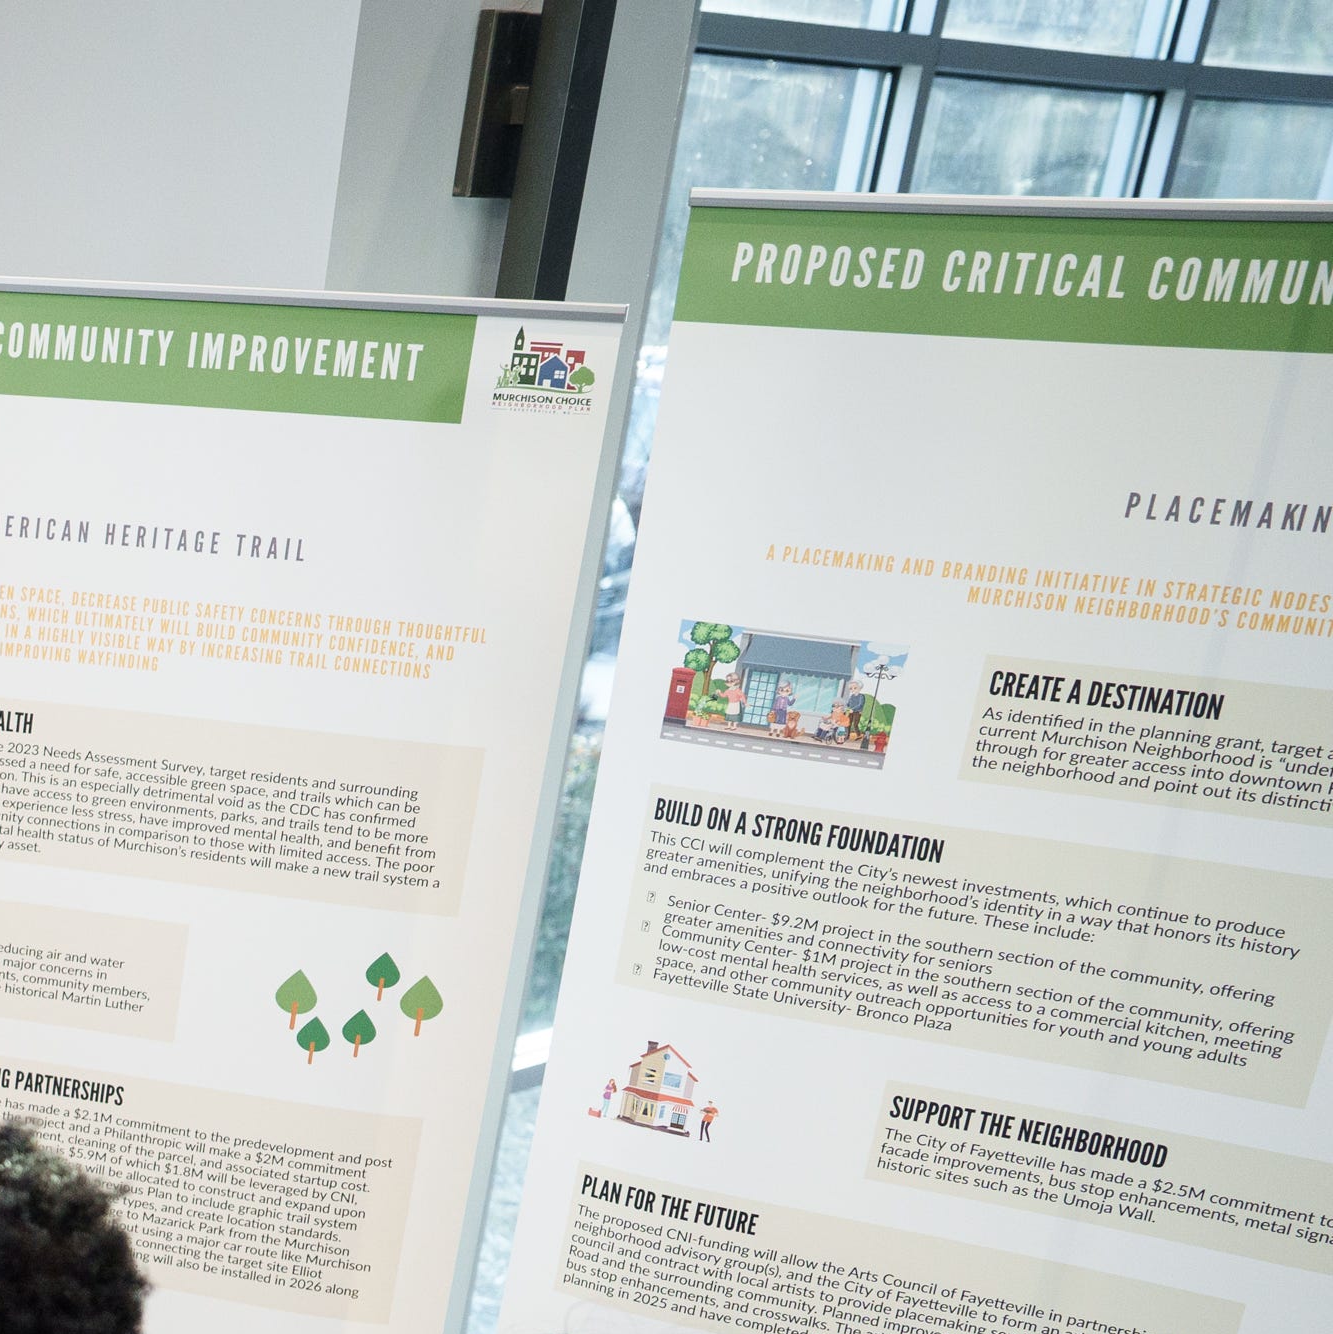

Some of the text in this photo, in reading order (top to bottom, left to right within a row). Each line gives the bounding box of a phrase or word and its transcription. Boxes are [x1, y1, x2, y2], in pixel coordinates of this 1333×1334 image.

[731, 241, 925, 290] PROPOSED
[942, 249, 1125, 299] CRITICAL
[187, 331, 424, 381] IMPROVEMENT
[492, 392, 591, 406] MURCHISON CHOICE
[104, 523, 220, 554] HERITAGE
[236, 533, 304, 562] TRAIL
[766, 543, 1331, 613] A PLACEMAKING AND BRANDING INITIATIVE IN STRATEGIC NODES
[967, 585, 1068, 612] MURCHISON
[1074, 596, 1230, 627] NEIGHBORHOOD'S
[0, 642, 71, 662] IMPROVING
[77, 649, 159, 672] WAYFINDING
[989, 670, 1225, 720] CREATE A DESTINATION
[7, 742, 39, 756] 2023
[43, 745, 81, 760] Needs
[84, 750, 157, 769] Assessment
[160, 759, 205, 776] Survey,
[210, 765, 246, 781] target
[250, 771, 308, 787] residents
[311, 778, 336, 790] and
[339, 782, 418, 802] surrounding
[654, 797, 945, 863] BUILD ON A STRONG FOUNDATION
[14, 1070, 124, 1106] PARTNERSHIPS
[889, 1095, 1168, 1168] SUPPORT THE NEIGHBORHOOD
[581, 1174, 759, 1236] PLAN FOR THE FUTURE
[876, 1156, 1155, 1222] historic sites such as the Umoja Wall.
